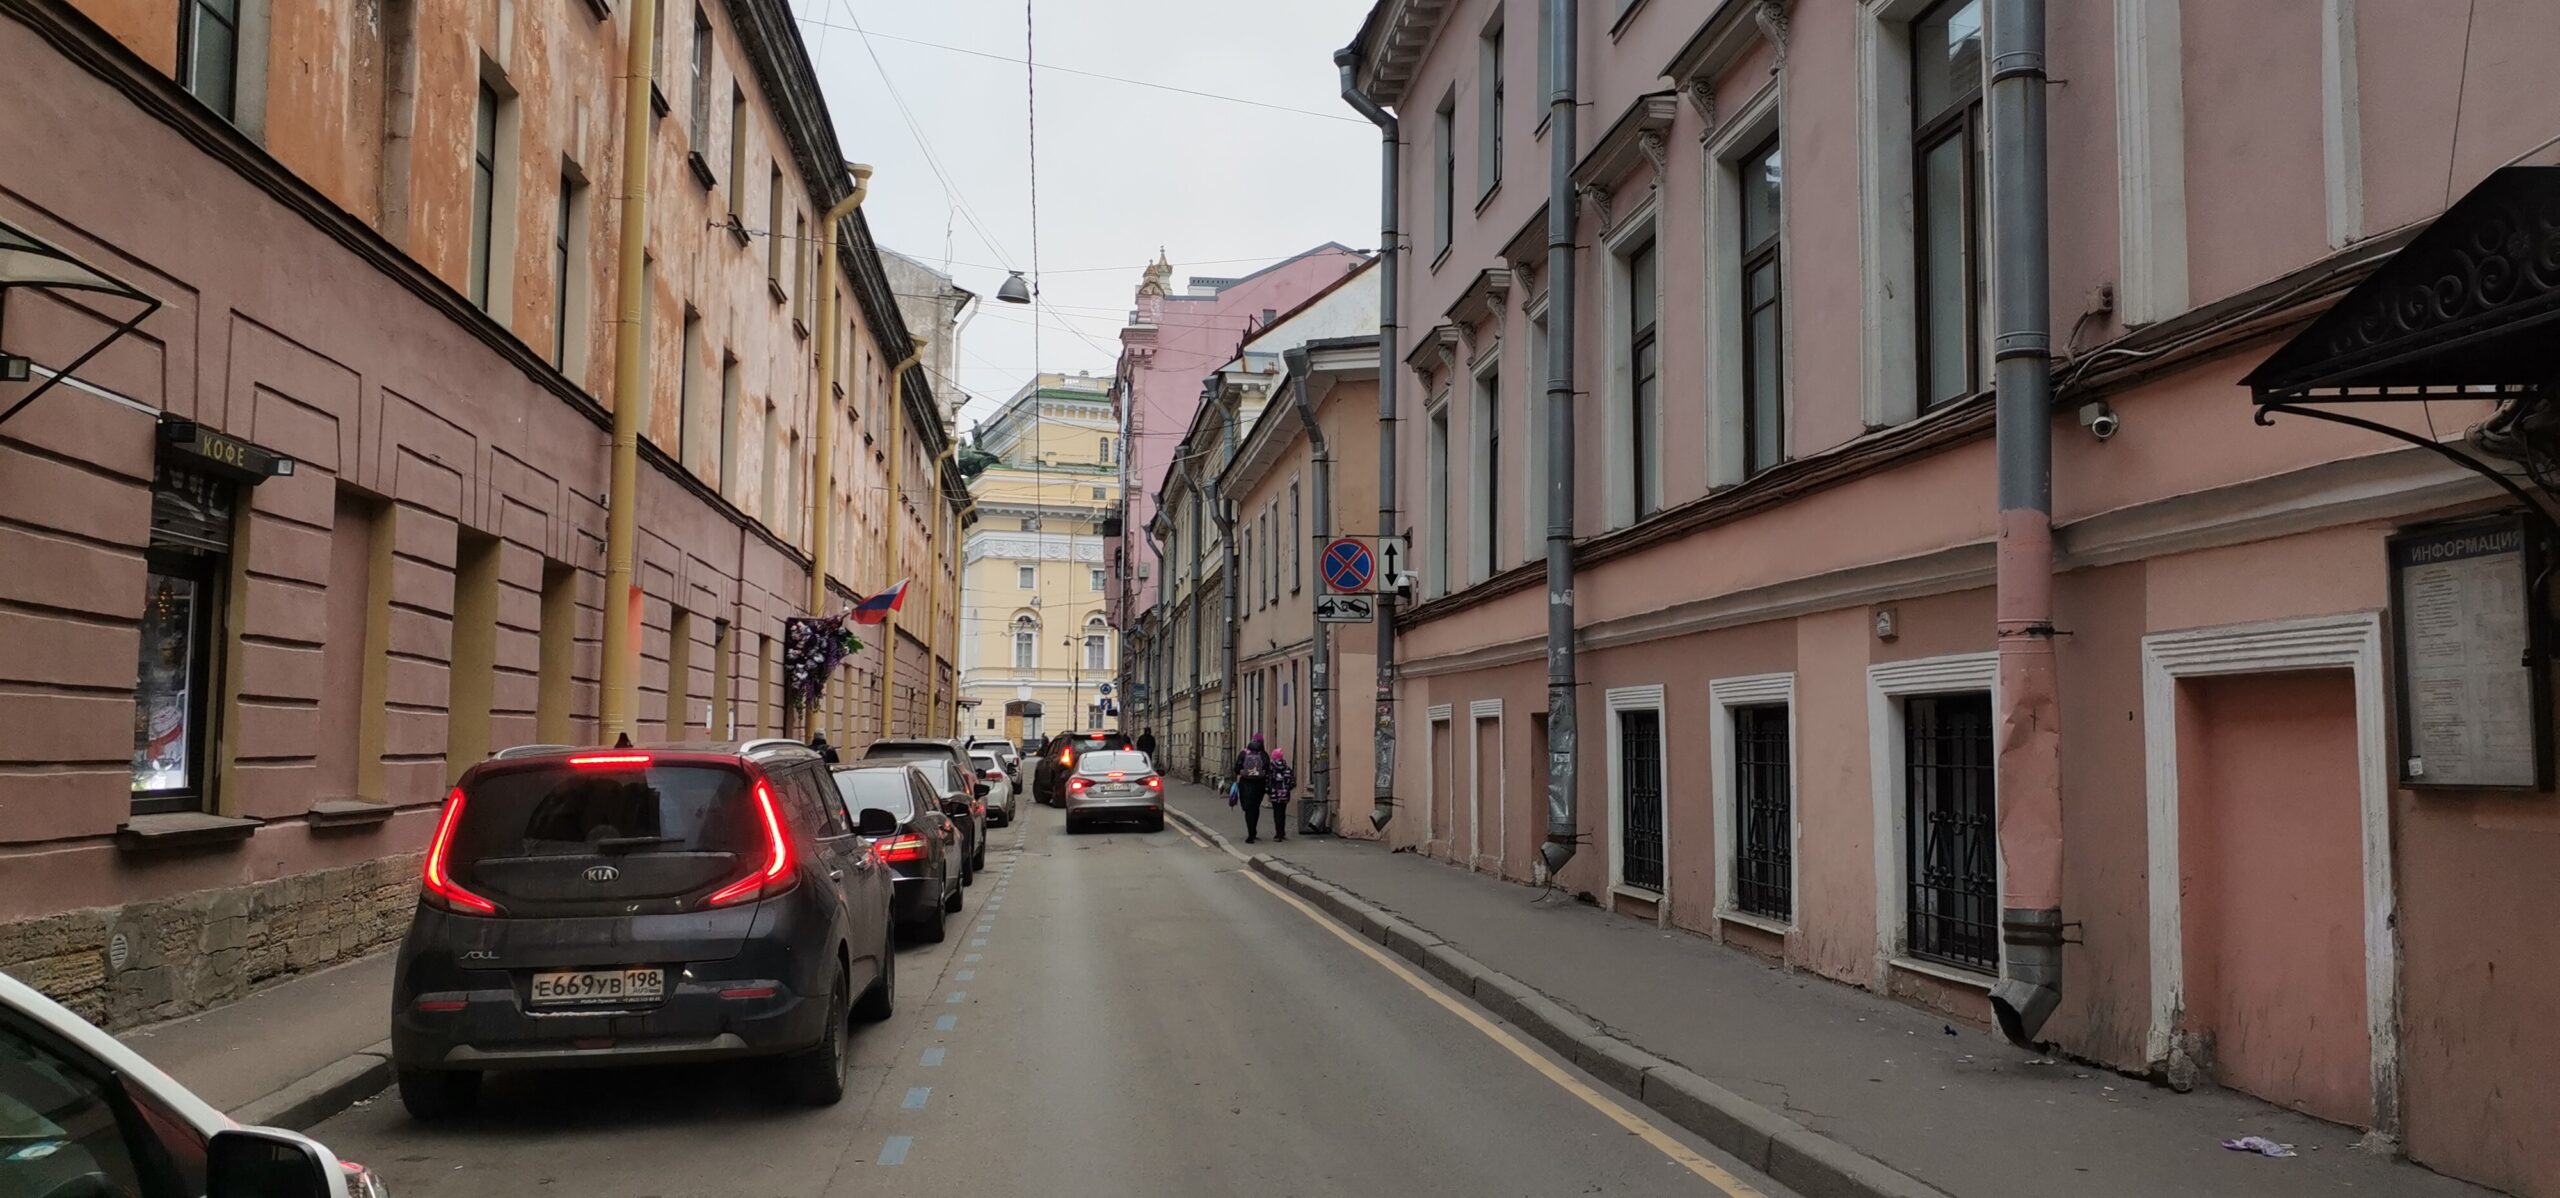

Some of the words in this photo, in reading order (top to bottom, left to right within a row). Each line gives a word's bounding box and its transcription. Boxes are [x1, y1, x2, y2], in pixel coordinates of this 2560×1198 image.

[203, 435, 245, 467] КОФЕ
[2411, 530, 2521, 562] ИНФОРМАЦИЯ
[587, 869, 614, 881] KIA
[627, 971, 658, 988] 198
